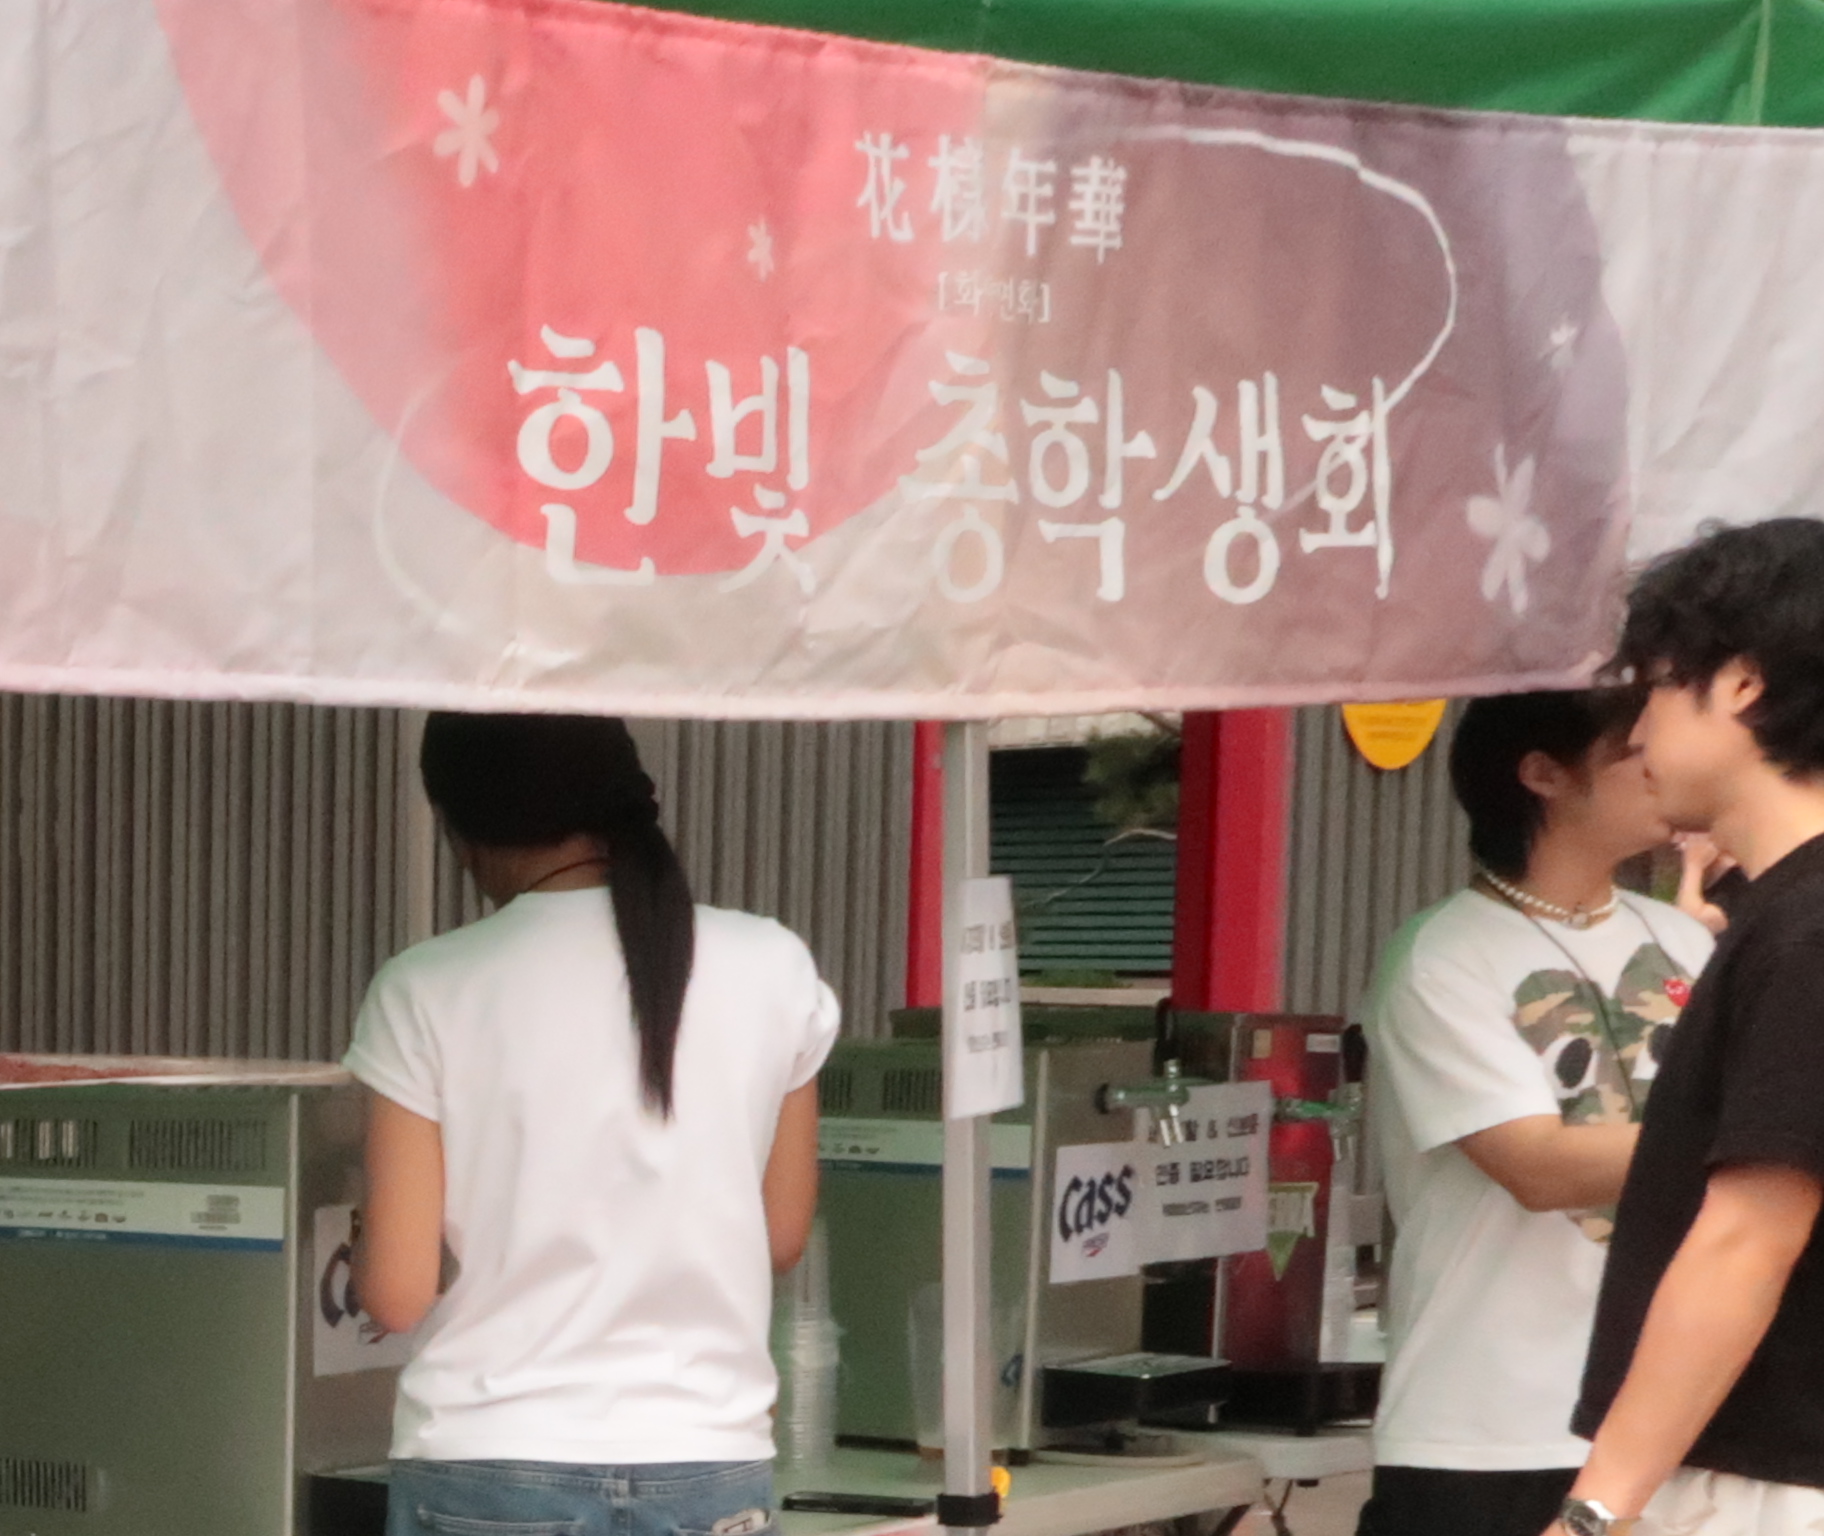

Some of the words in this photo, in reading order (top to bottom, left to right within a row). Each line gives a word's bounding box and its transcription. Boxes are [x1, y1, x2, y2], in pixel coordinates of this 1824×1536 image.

[508, 325, 817, 595] 한빛
[899, 350, 1400, 603] 총학생회
[1059, 1165, 1135, 1242] Cass
